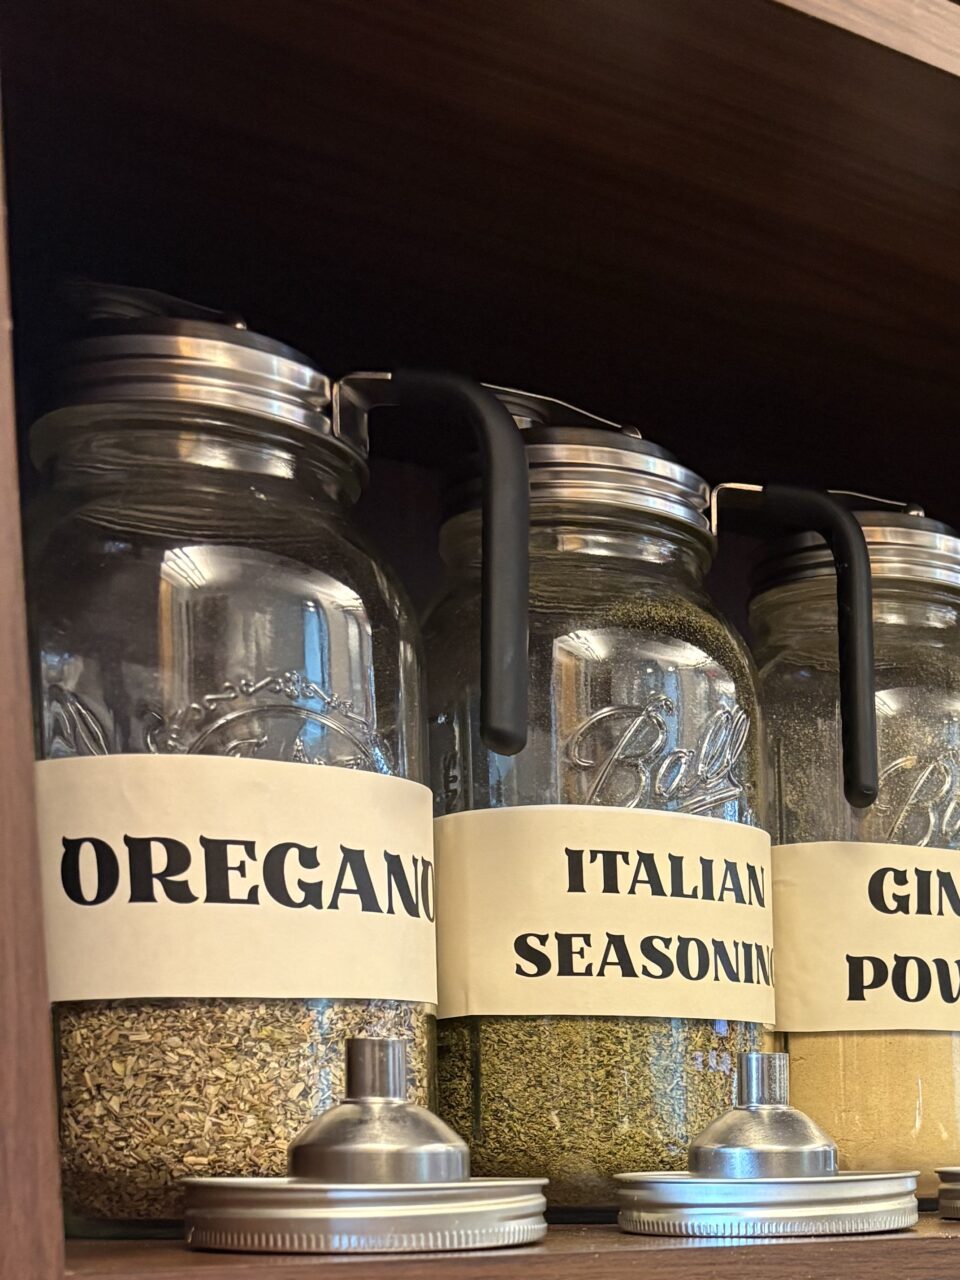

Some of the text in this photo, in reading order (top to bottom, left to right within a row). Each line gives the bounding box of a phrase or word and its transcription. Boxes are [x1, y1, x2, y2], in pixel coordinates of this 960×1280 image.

[60, 833, 434, 923] OREGANO
[564, 846, 766, 908] ITALIAN
[513, 930, 774, 989] SEASONIN
